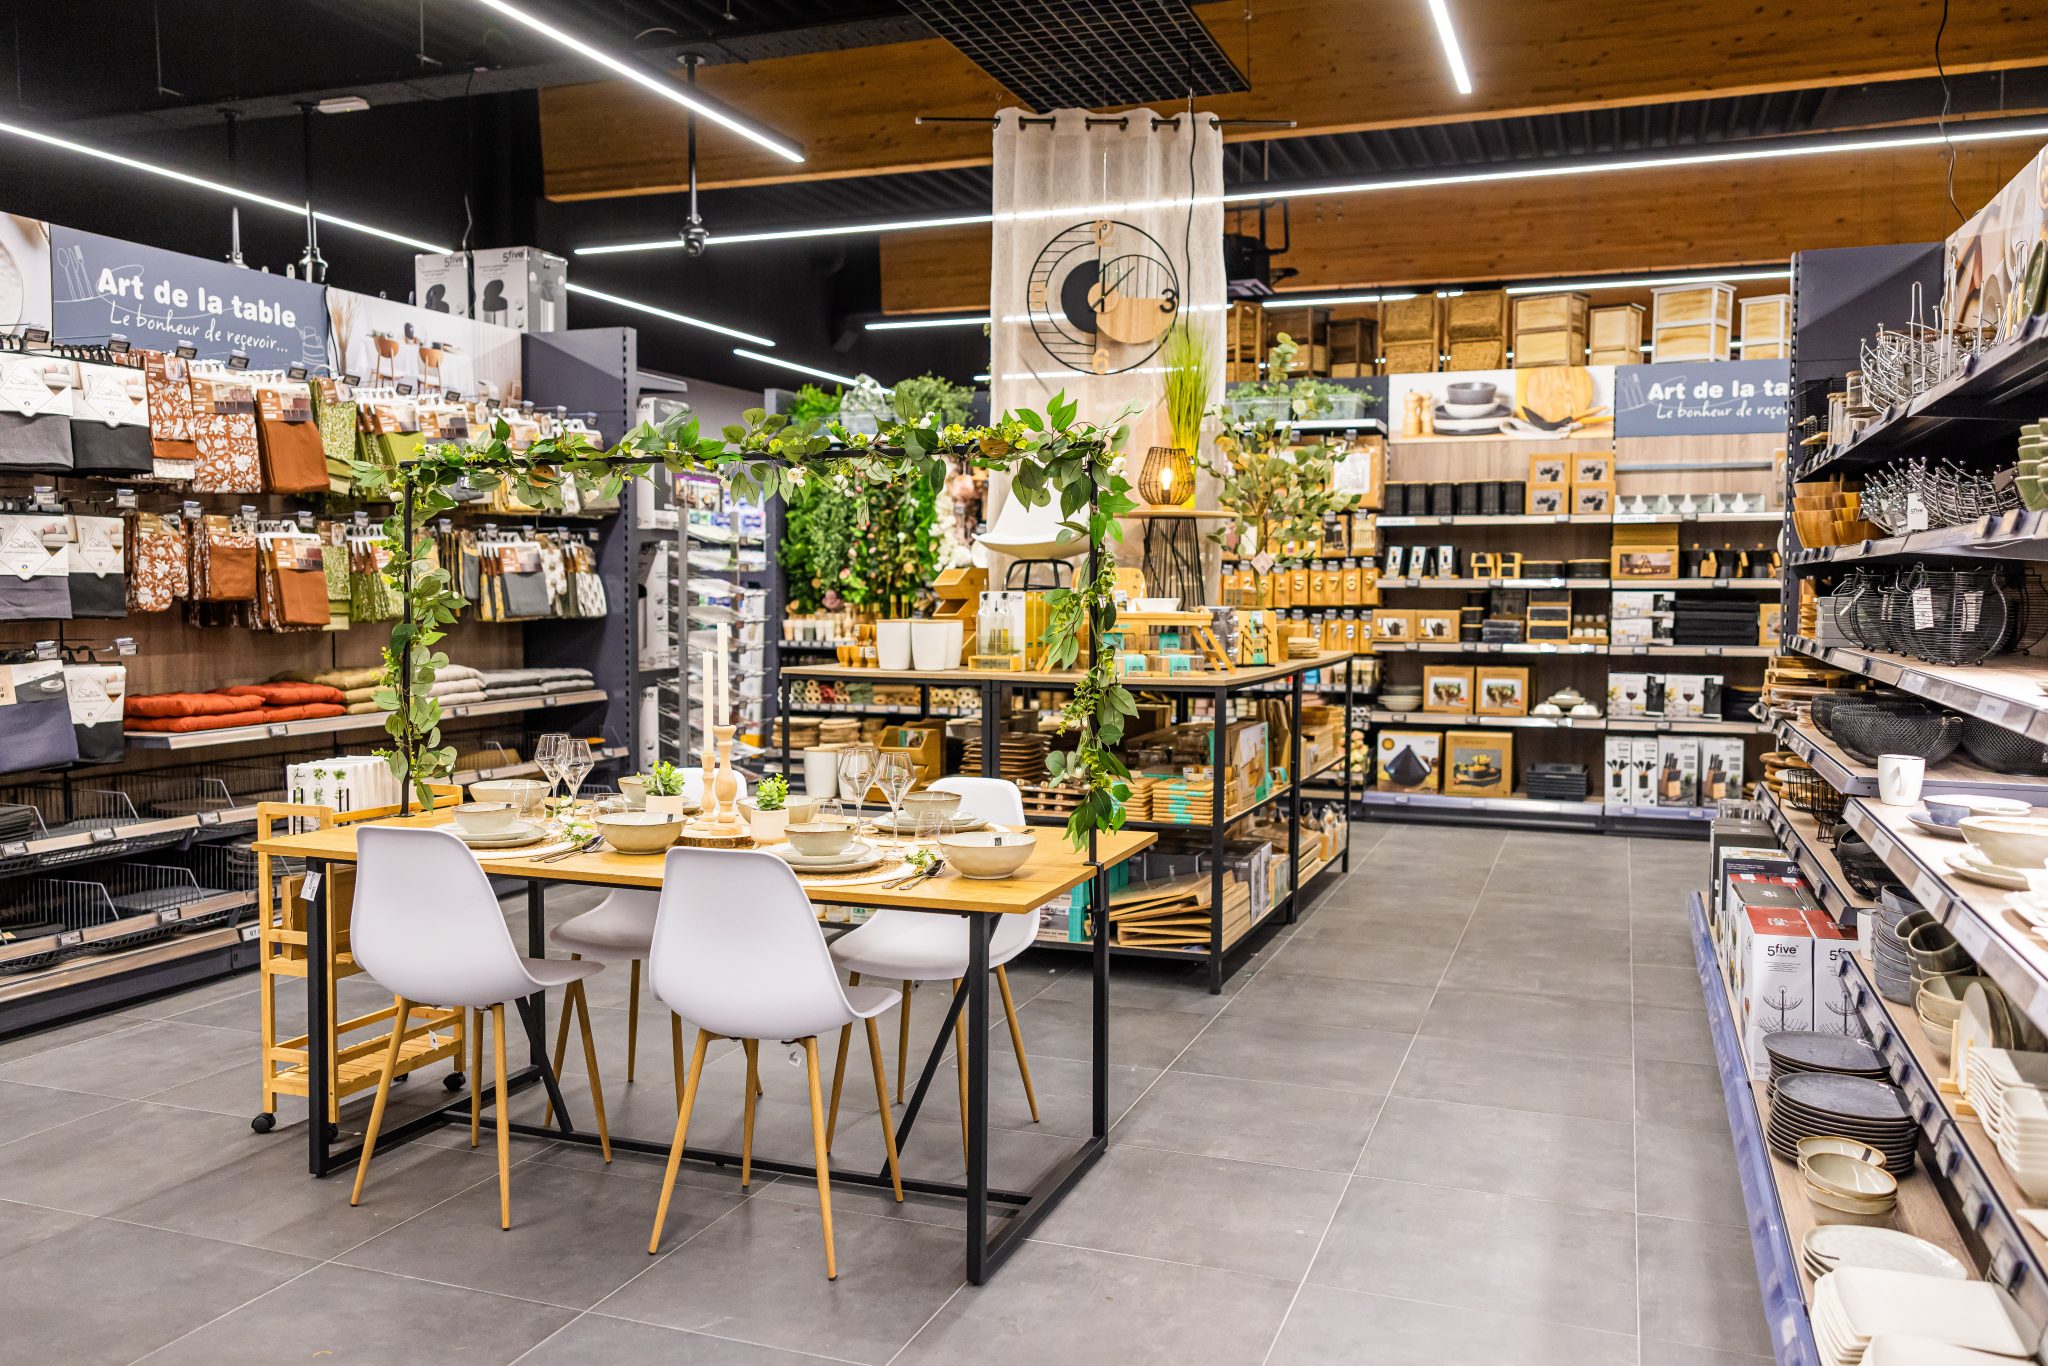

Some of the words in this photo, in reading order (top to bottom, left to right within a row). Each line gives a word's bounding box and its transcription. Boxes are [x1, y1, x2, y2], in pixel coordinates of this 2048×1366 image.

[97, 268, 144, 300] Art
[154, 280, 188, 307] de
[198, 287, 222, 315] la
[232, 295, 296, 328] table
[1159, 288, 1177, 313] 3
[110, 301, 130, 326] Le
[136, 304, 200, 337] bonheur
[204, 318, 222, 343] de
[1093, 348, 1110, 376] 6
[1648, 382, 1686, 400] Art
[1693, 381, 1724, 399] de
[1732, 379, 1754, 398] la
[1657, 402, 1673, 419] Le
[1677, 400, 1732, 418] bonheur
[1735, 400, 1752, 418] de
[1767, 943, 1799, 956] 5five
